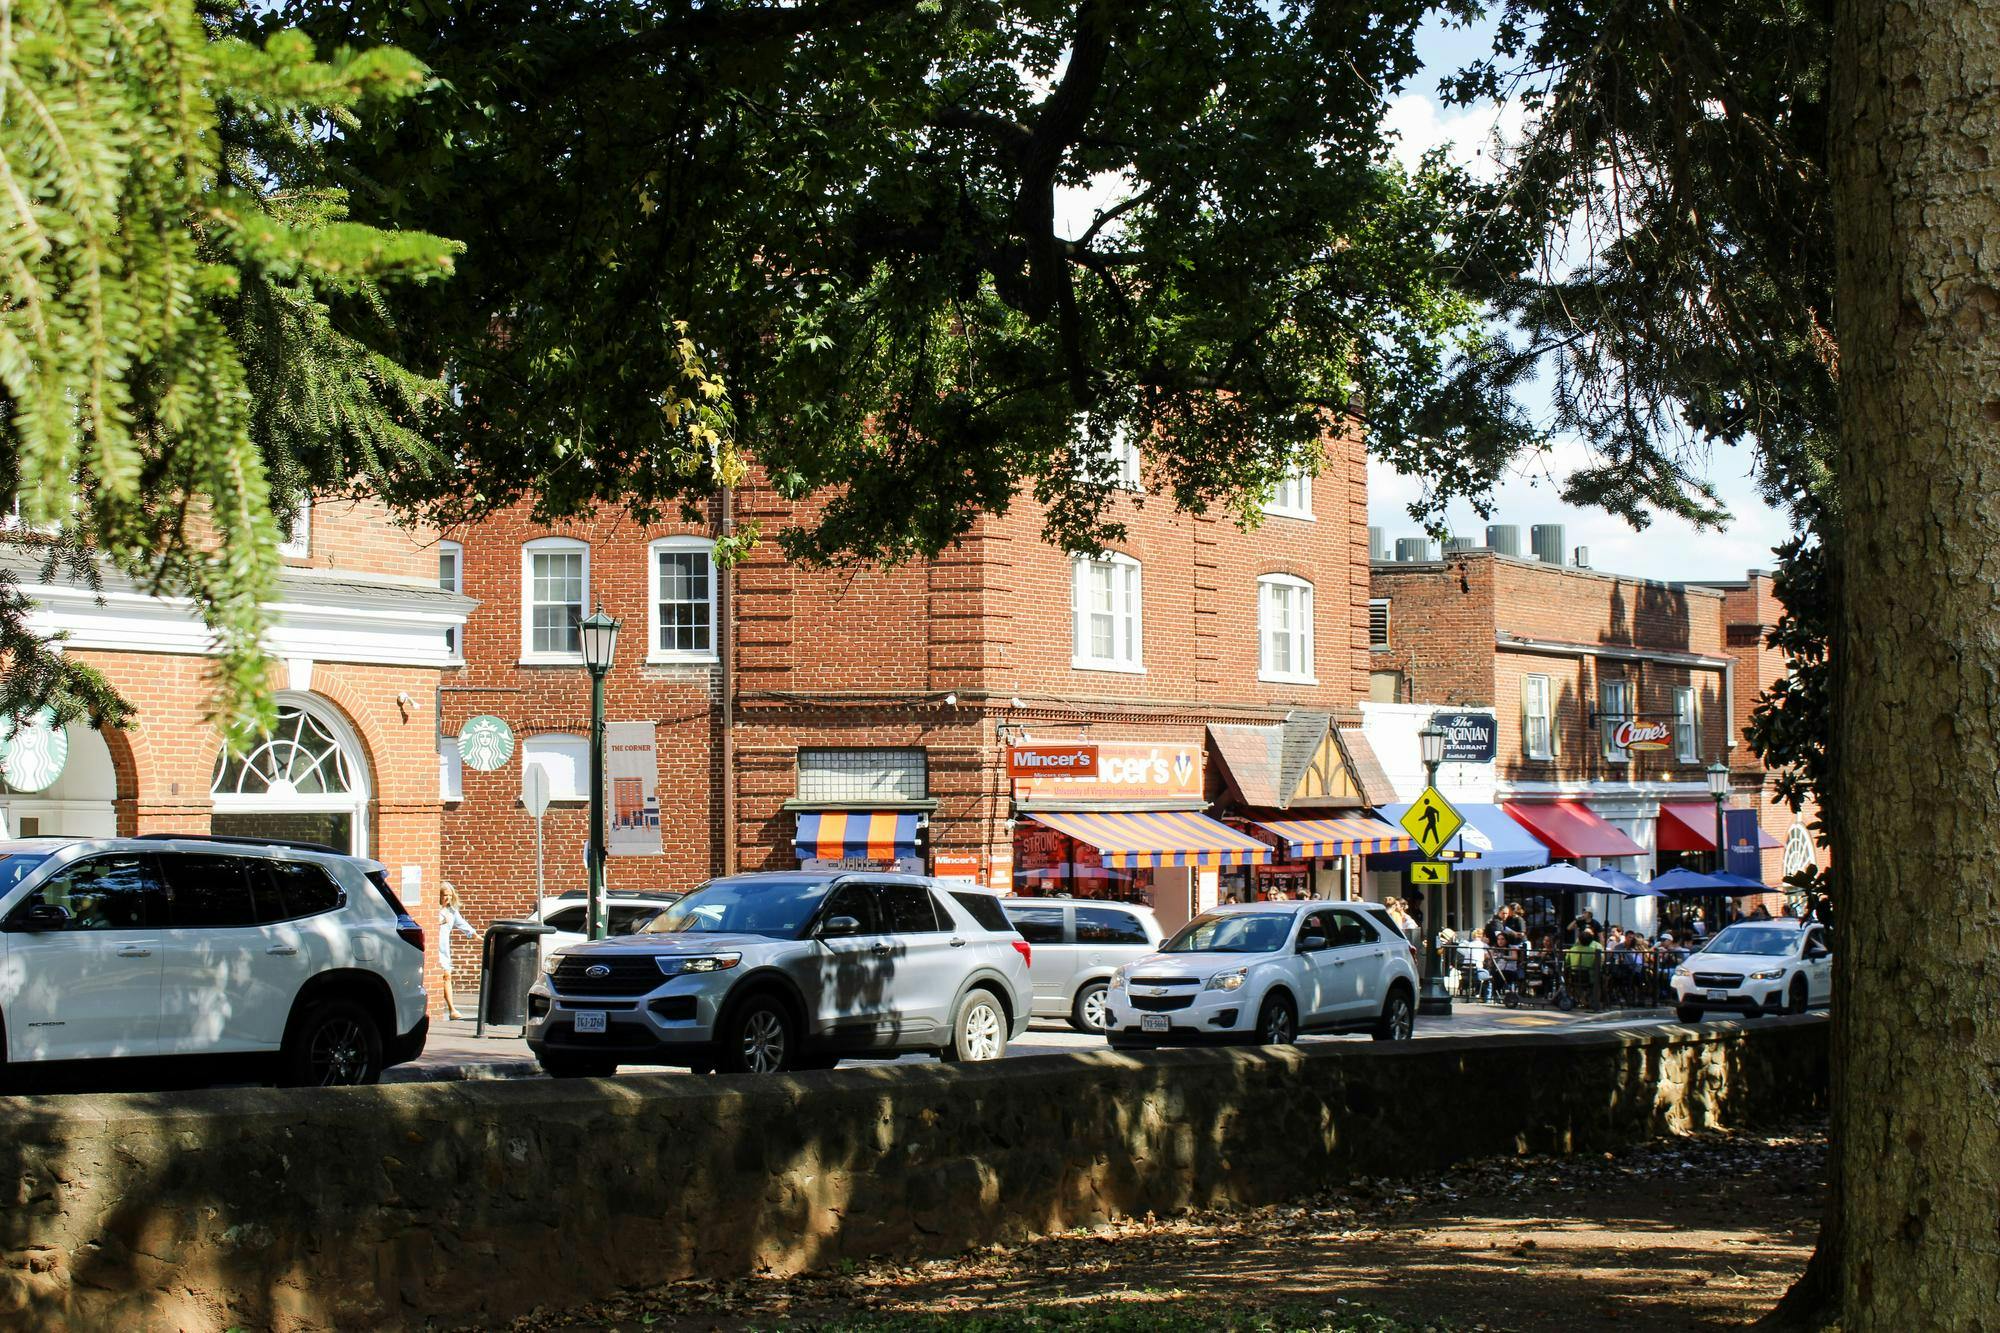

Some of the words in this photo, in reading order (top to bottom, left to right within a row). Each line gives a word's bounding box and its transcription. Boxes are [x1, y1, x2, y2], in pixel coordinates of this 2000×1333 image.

[1451, 715, 1473, 727] The
[1437, 726, 1490, 744] IRGINIAN
[1616, 721, 1670, 747] Cane's
[611, 744, 624, 752] THE
[624, 744, 651, 752] CORNER
[1013, 750, 1091, 767] Mincer's
[1023, 832, 1059, 853] STRONG
[935, 856, 977, 864] Mincer's
